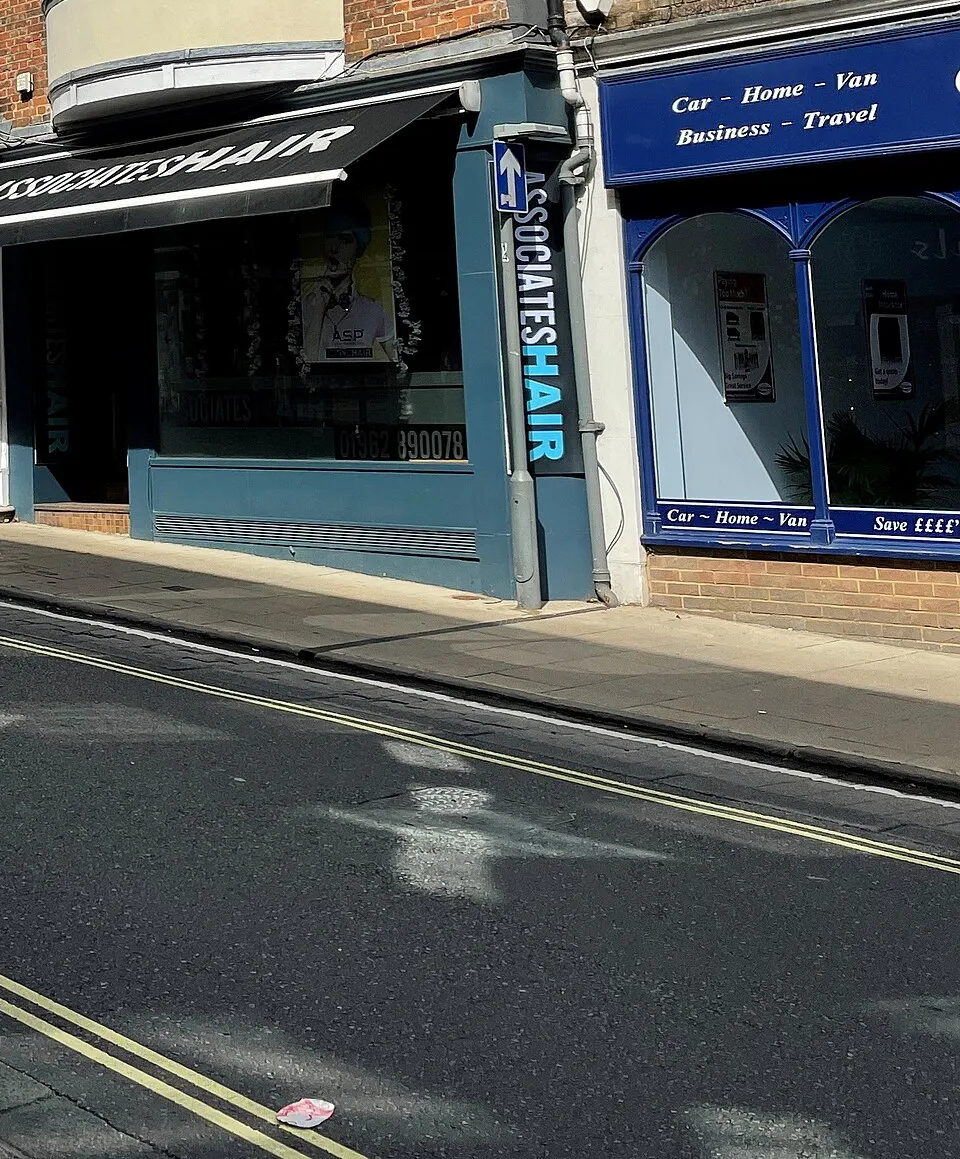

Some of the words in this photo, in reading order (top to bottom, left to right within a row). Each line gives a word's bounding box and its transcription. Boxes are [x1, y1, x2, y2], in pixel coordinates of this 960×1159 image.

[672, 96, 712, 113] Car
[740, 83, 804, 105] Home
[835, 71, 878, 91] Van
[676, 123, 771, 146] Business
[803, 103, 879, 130] Travel
[332, 329, 364, 341] ASP
[340, 430, 390, 458] 01962
[397, 430, 464, 459] 890078
[666, 508, 695, 522] Car
[715, 510, 758, 526] Home
[779, 512, 808, 527] Van
[873, 516, 908, 532] Save
